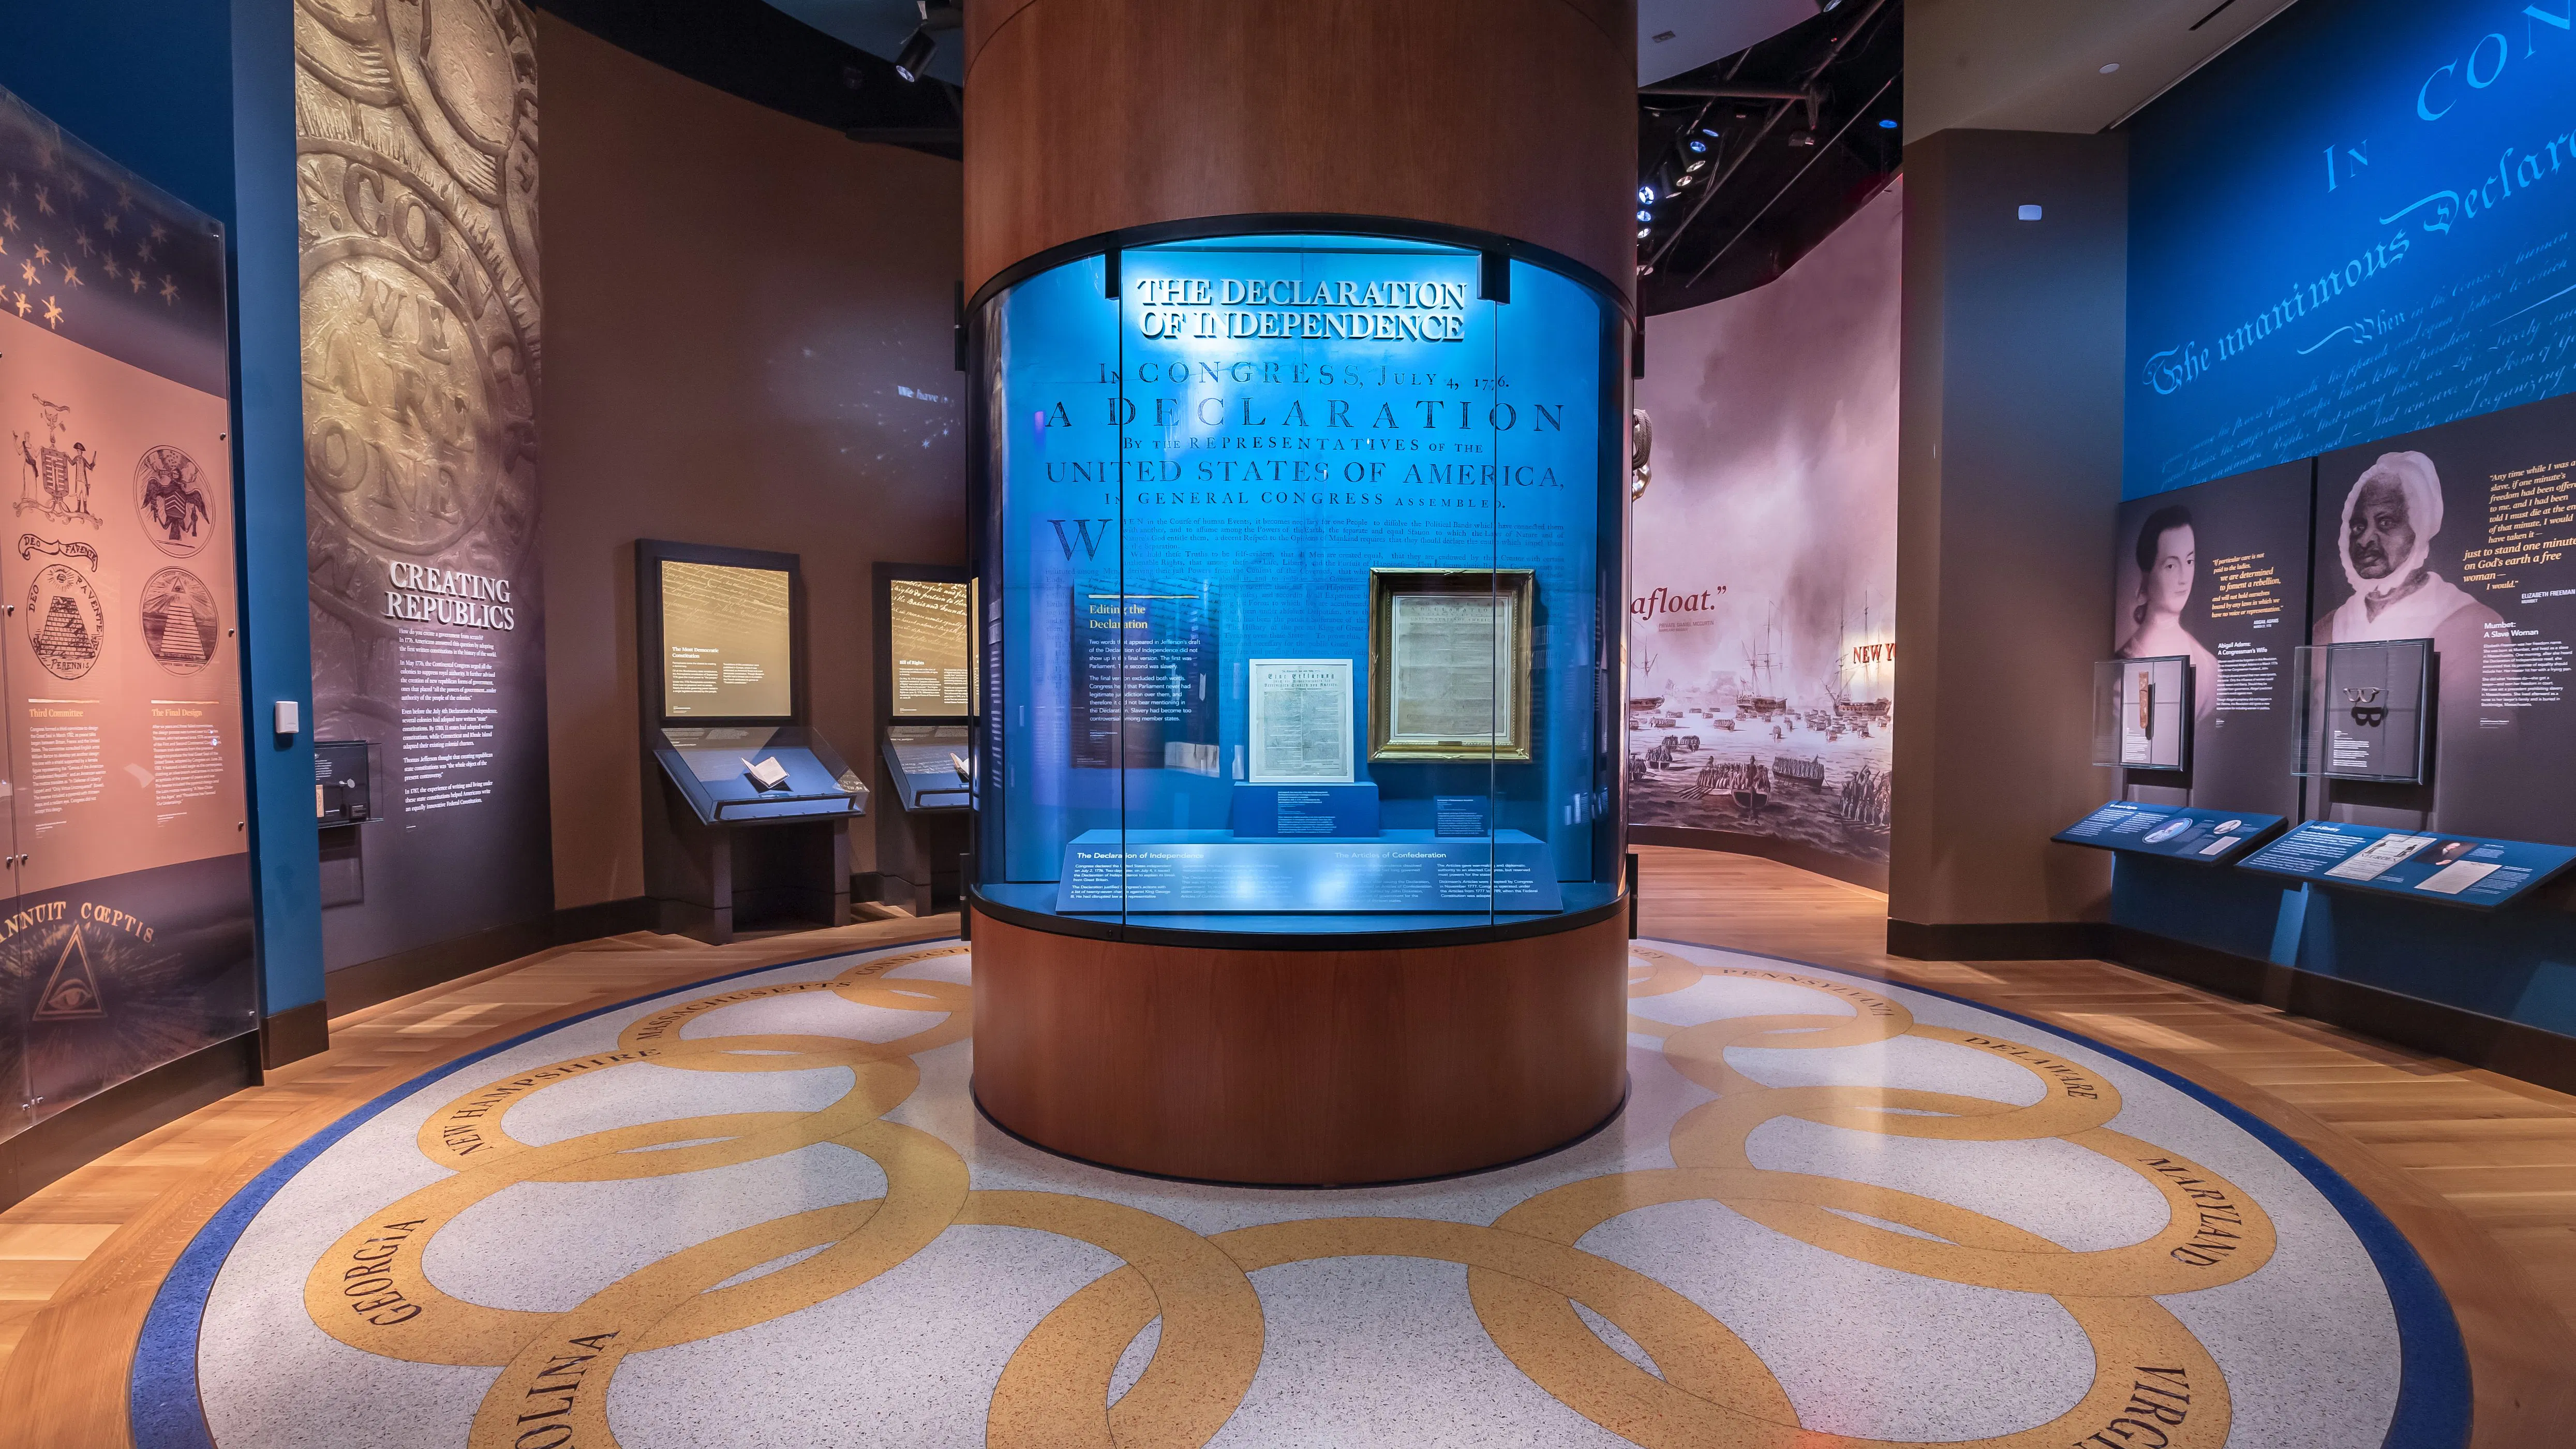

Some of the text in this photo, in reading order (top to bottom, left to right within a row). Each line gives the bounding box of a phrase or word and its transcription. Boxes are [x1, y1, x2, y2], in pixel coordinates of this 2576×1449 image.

[1137, 278, 1467, 310] THE DECLARATION
[2143, 340, 2210, 394] The
[2219, 228, 2410, 362] unanimous
[1139, 312, 1466, 343] OF INDEPENDENCE
[1446, 377, 1459, 389] 4,
[1045, 397, 1565, 432] A DECLARATION
[1153, 439, 1181, 449] THE
[1189, 436, 1419, 451] REPRESENTATIVES
[1429, 442, 1445, 452] OF
[1455, 443, 1483, 453] THE
[1045, 460, 1564, 491] UNITED STATES OF AMERICA,
[2508, 470, 2525, 478] time
[2527, 465, 2546, 475] while
[2512, 480, 2519, 489] if
[1138, 492, 1248, 505] GENERAL
[1261, 492, 1383, 505] CONGRESS
[24, 537, 41, 547] DEO
[2463, 550, 2481, 561] just
[2495, 542, 2522, 555] stand
[2523, 542, 2541, 551] one
[2505, 554, 2530, 565] earth
[2540, 551, 2562, 564] free
[389, 561, 511, 603] CREATING
[2240, 567, 2274, 579] determined
[2464, 573, 2496, 582] woman
[2226, 582, 2246, 592] foment
[28, 585, 39, 613] DEO
[384, 591, 514, 631] REPUBLICS
[1129, 604, 1145, 614] the
[1853, 644, 1882, 663] NEW
[51, 659, 90, 670] PERENNIS
[29, 709, 83, 717] Third Committee
[182, 709, 202, 718] Design
[1724, 968, 1895, 1017] PENNSYLVANIA
[636, 981, 852, 1041] MASSACHUSETTS
[1964, 1036, 2098, 1102] DELAWARE
[443, 1048, 662, 1156] NEW HAMPSHIRE
[2137, 1157, 2243, 1266] MARYLAND
[343, 1217, 429, 1326] GEORGIA
